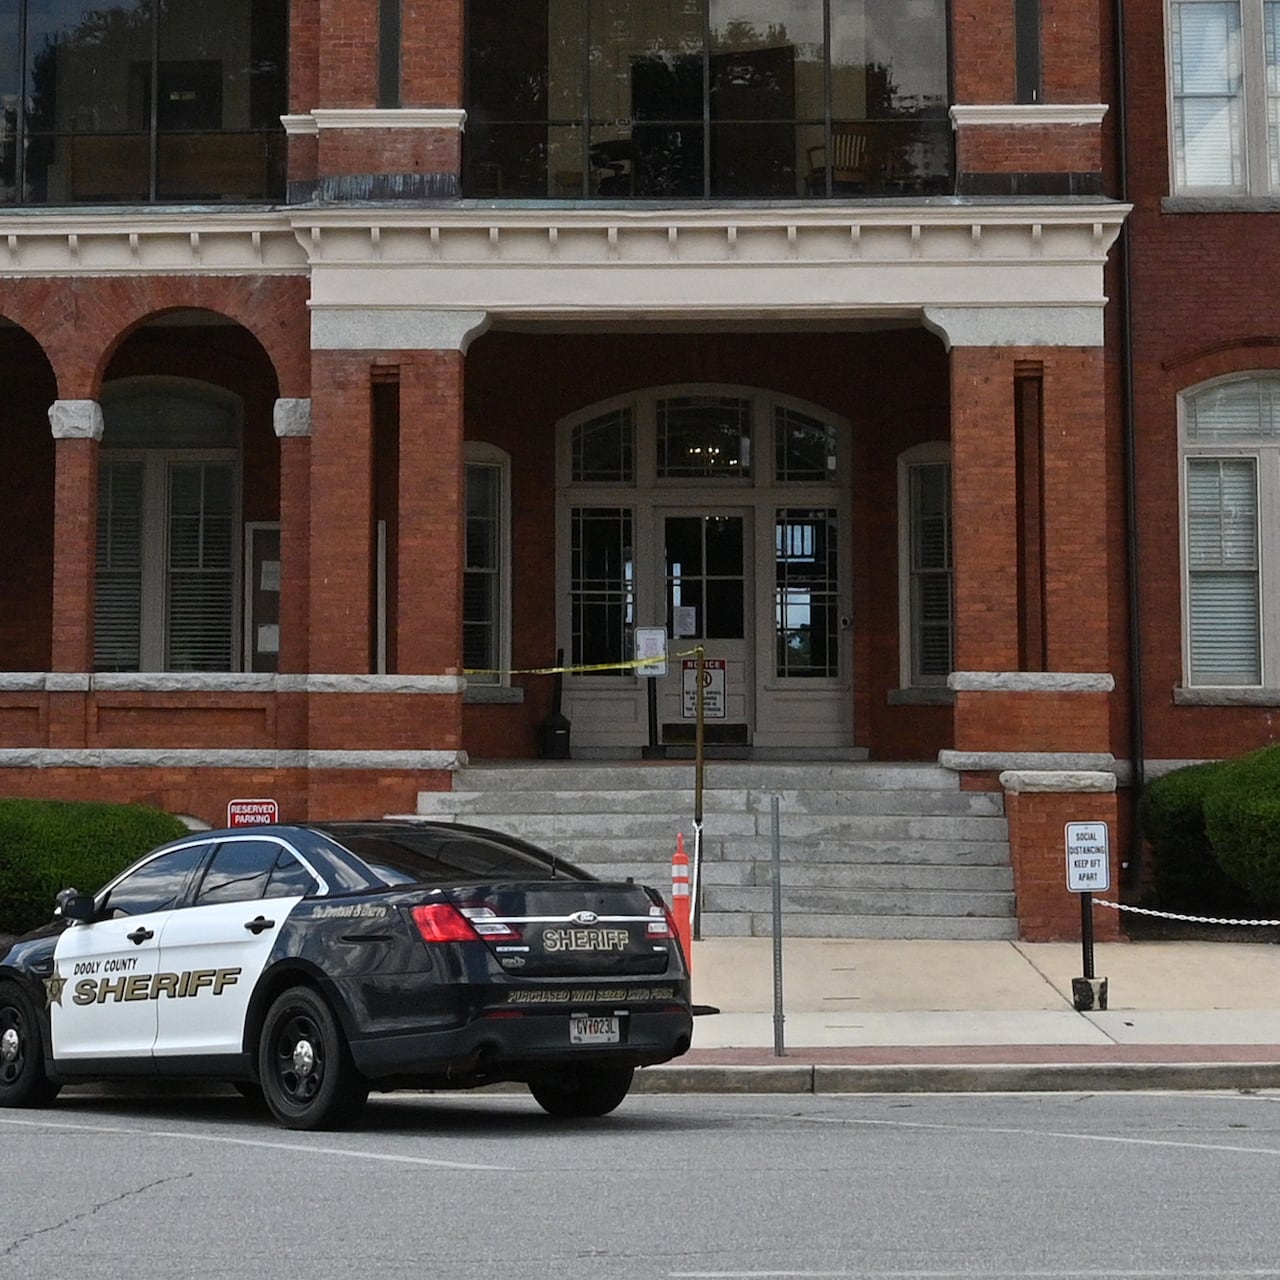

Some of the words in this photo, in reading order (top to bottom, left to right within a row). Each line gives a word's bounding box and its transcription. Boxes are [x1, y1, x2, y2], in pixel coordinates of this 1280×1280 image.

[687, 661, 720, 669] NOICE
[231, 804, 275, 814] RESERVED
[234, 814, 271, 824] PARKING
[1076, 832, 1097, 841] SOCIAL
[1069, 846, 1105, 855] DISTANCING
[1074, 859, 1089, 868] KEEP
[1090, 859, 1100, 868] 6FT
[1078, 873, 1097, 881] APART
[543, 928, 629, 952] SHERIFF
[73, 960, 102, 976] DOOLY
[104, 957, 139, 972] COUNTY
[72, 967, 243, 1006] SHERIFF
[507, 989, 571, 1003] PURCHASED
